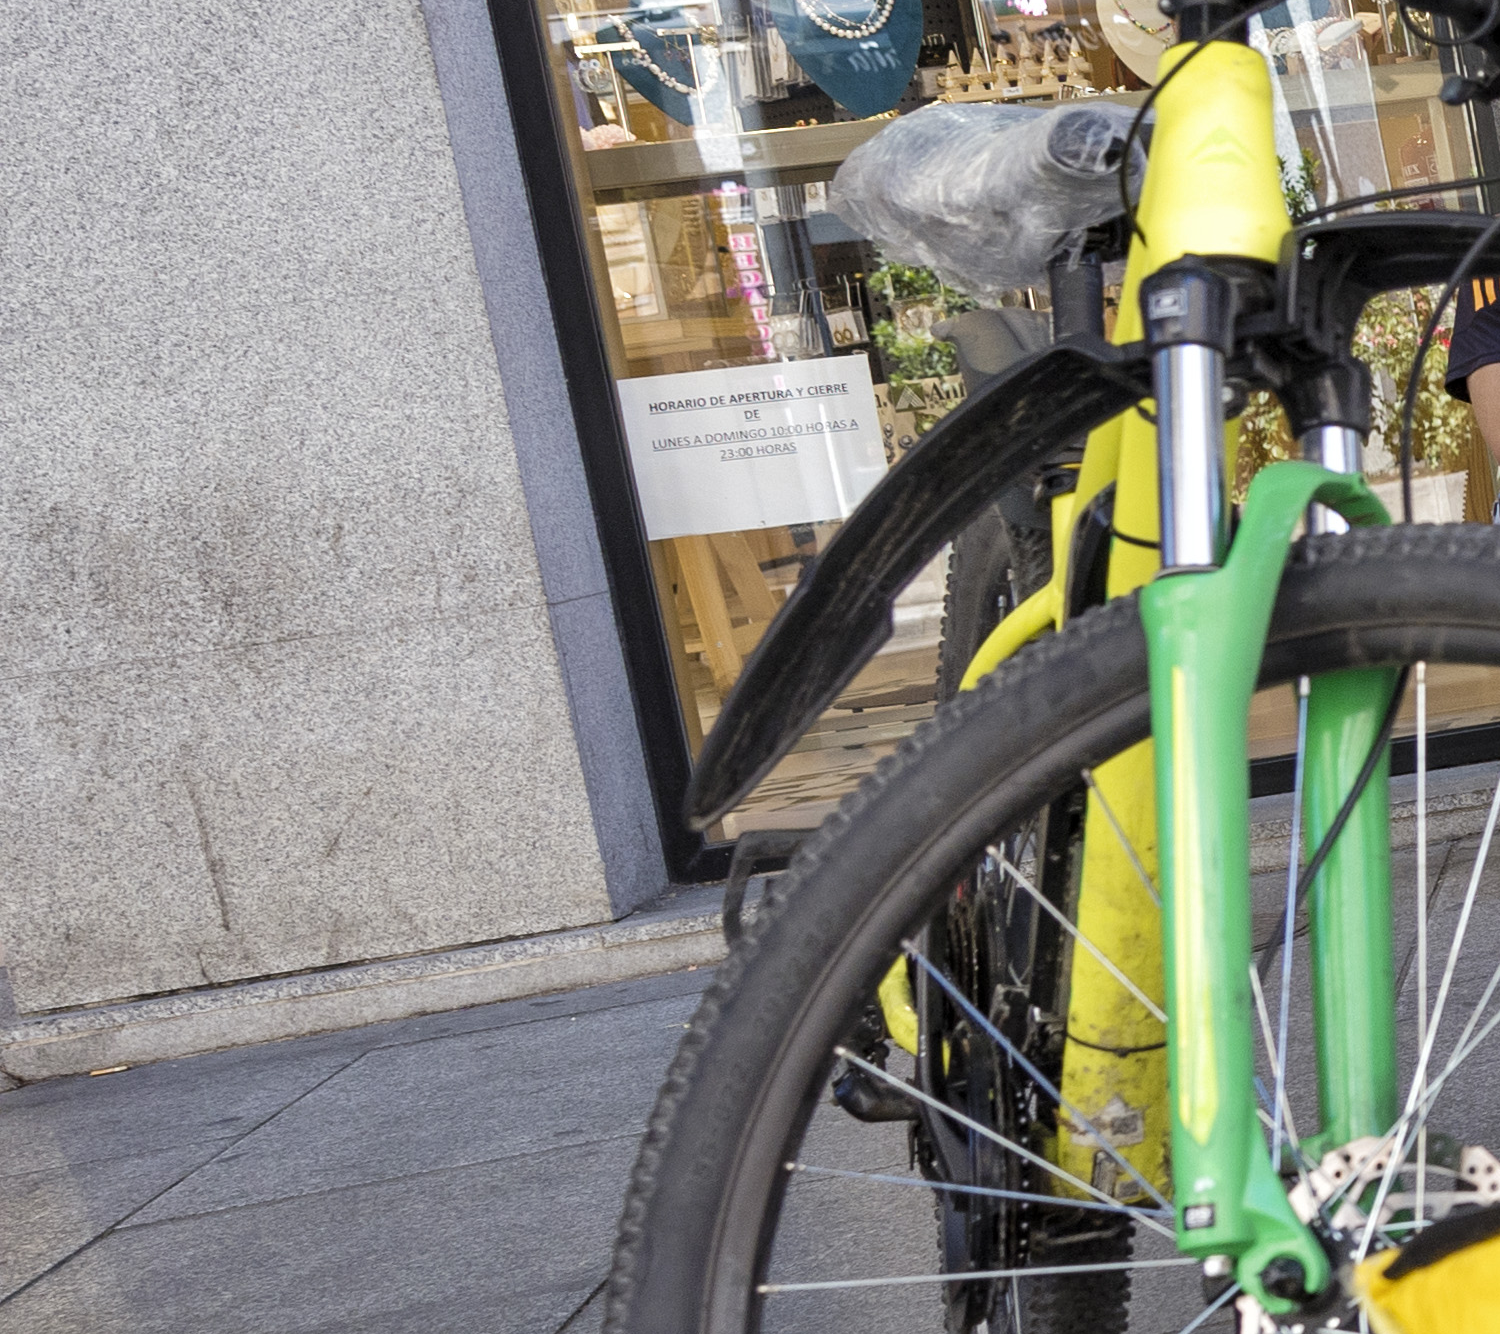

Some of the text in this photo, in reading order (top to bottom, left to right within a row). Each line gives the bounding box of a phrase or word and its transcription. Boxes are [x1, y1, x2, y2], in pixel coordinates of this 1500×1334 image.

[648, 382, 849, 413] HORARIO DE APERTURA Y CIERRE
[743, 408, 761, 421] DE
[652, 436, 692, 451] LUNES
[693, 434, 703, 446] A
[705, 427, 768, 444] DOMINGO
[806, 419, 848, 433] HORAS
[849, 418, 860, 429] A
[720, 442, 798, 461] 23:00 HORAS
